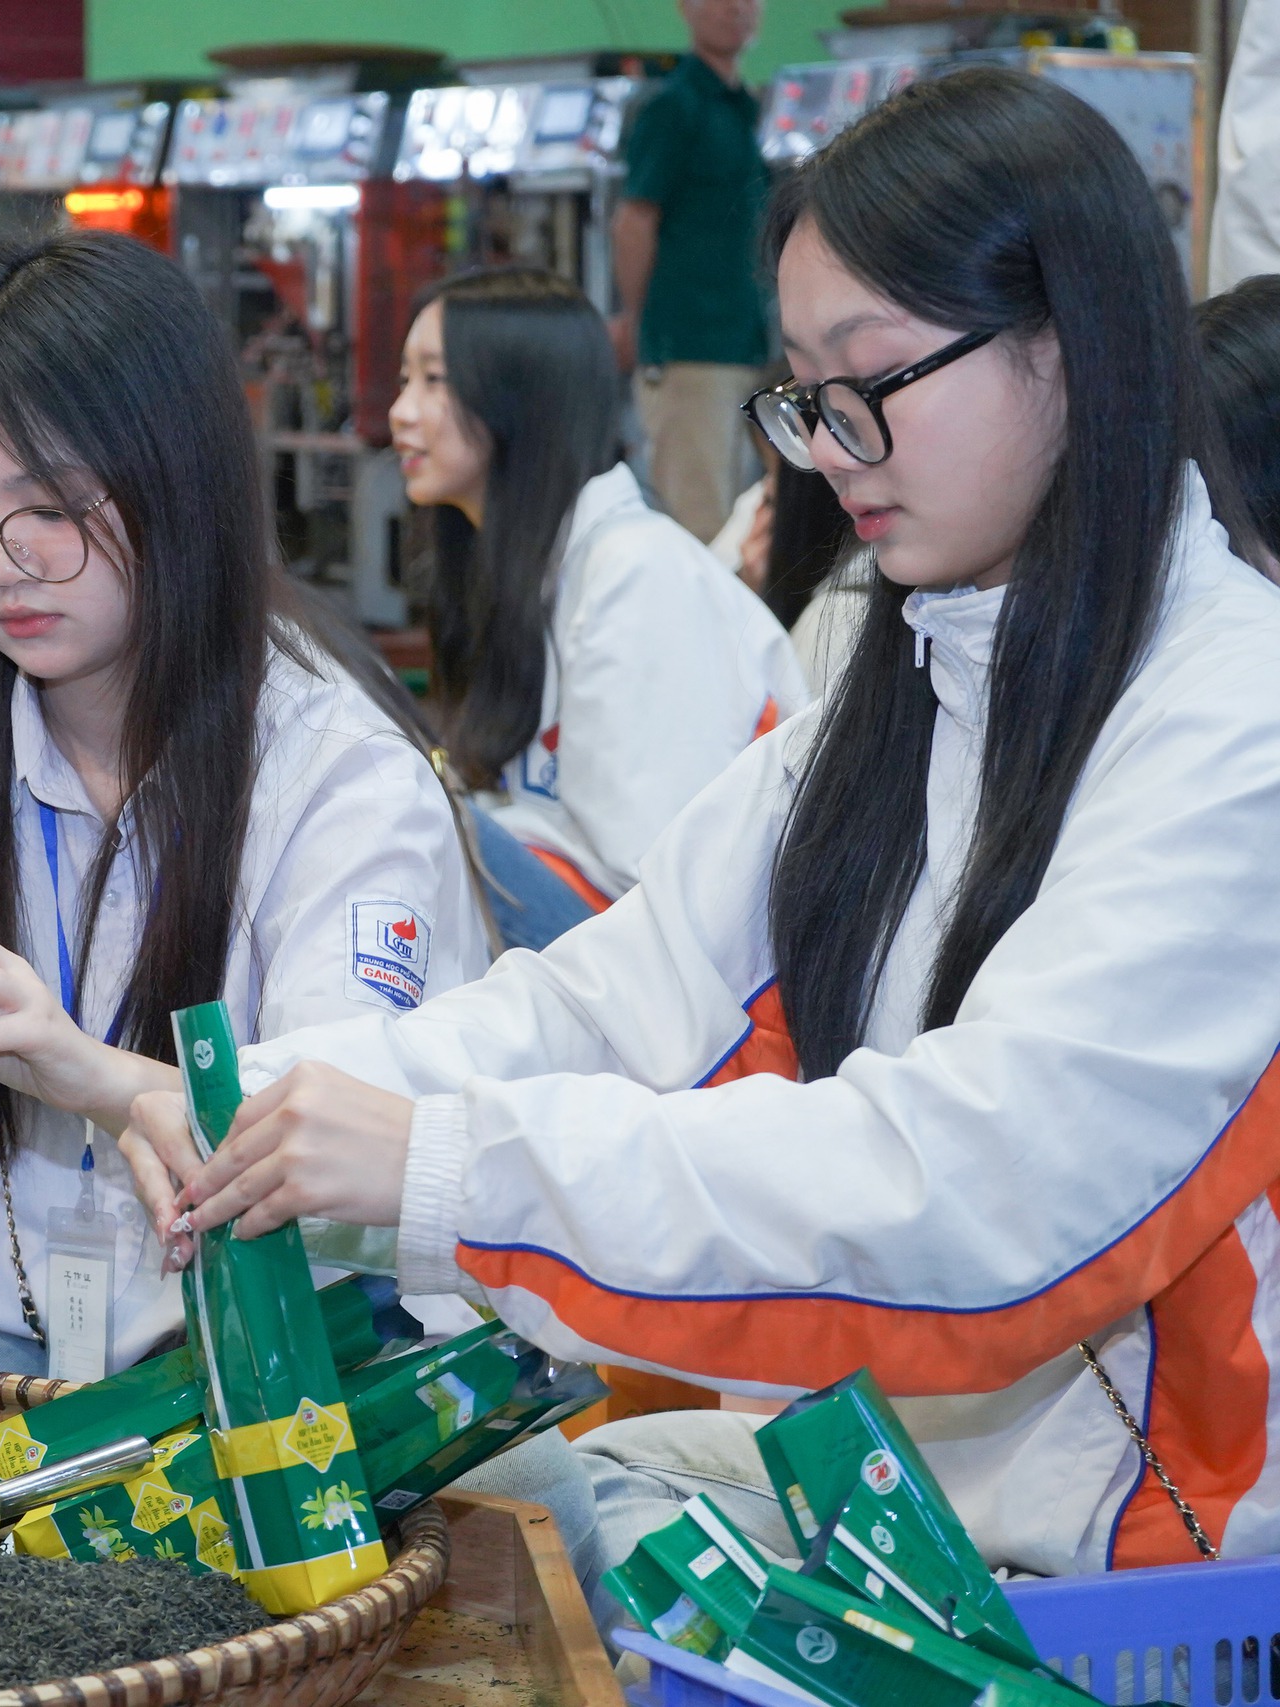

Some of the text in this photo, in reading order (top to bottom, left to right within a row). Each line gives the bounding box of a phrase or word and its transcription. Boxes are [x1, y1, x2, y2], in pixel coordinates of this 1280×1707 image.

[360, 956, 384, 967] TRUNG
[386, 963, 399, 972] HỌC
[364, 967, 400, 986] GANG
